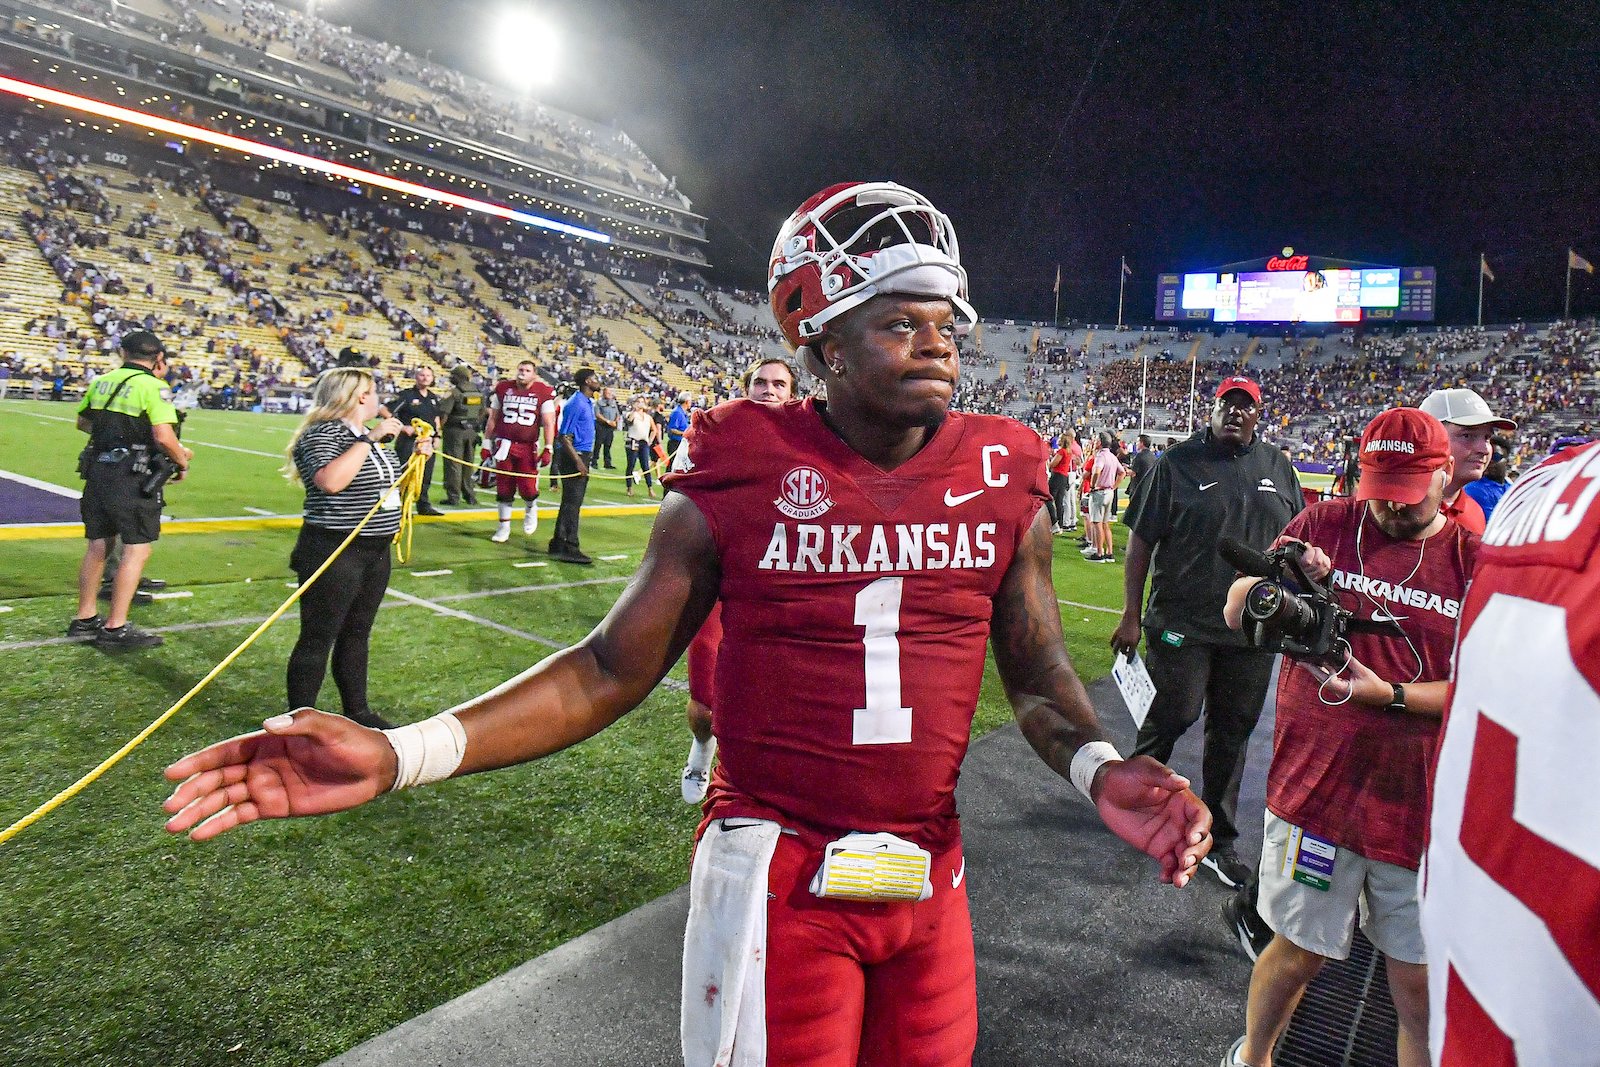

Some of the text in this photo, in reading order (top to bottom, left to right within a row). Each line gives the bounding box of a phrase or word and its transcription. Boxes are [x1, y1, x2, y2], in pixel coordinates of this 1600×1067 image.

[104, 151, 129, 165] 102
[1266, 255, 1309, 271] Coca-Cola
[1366, 309, 1394, 319] LSU
[94, 381, 134, 399] POLCE
[502, 402, 537, 426] 55
[1364, 439, 1415, 454] ARKANSAS
[981, 444, 1010, 488] C
[786, 469, 823, 505] SEC
[782, 504, 825, 518] GRADUATE
[758, 522, 997, 573] ARKANSAS
[1331, 568, 1462, 620] ARKANSAS
[852, 576, 913, 746] 1
